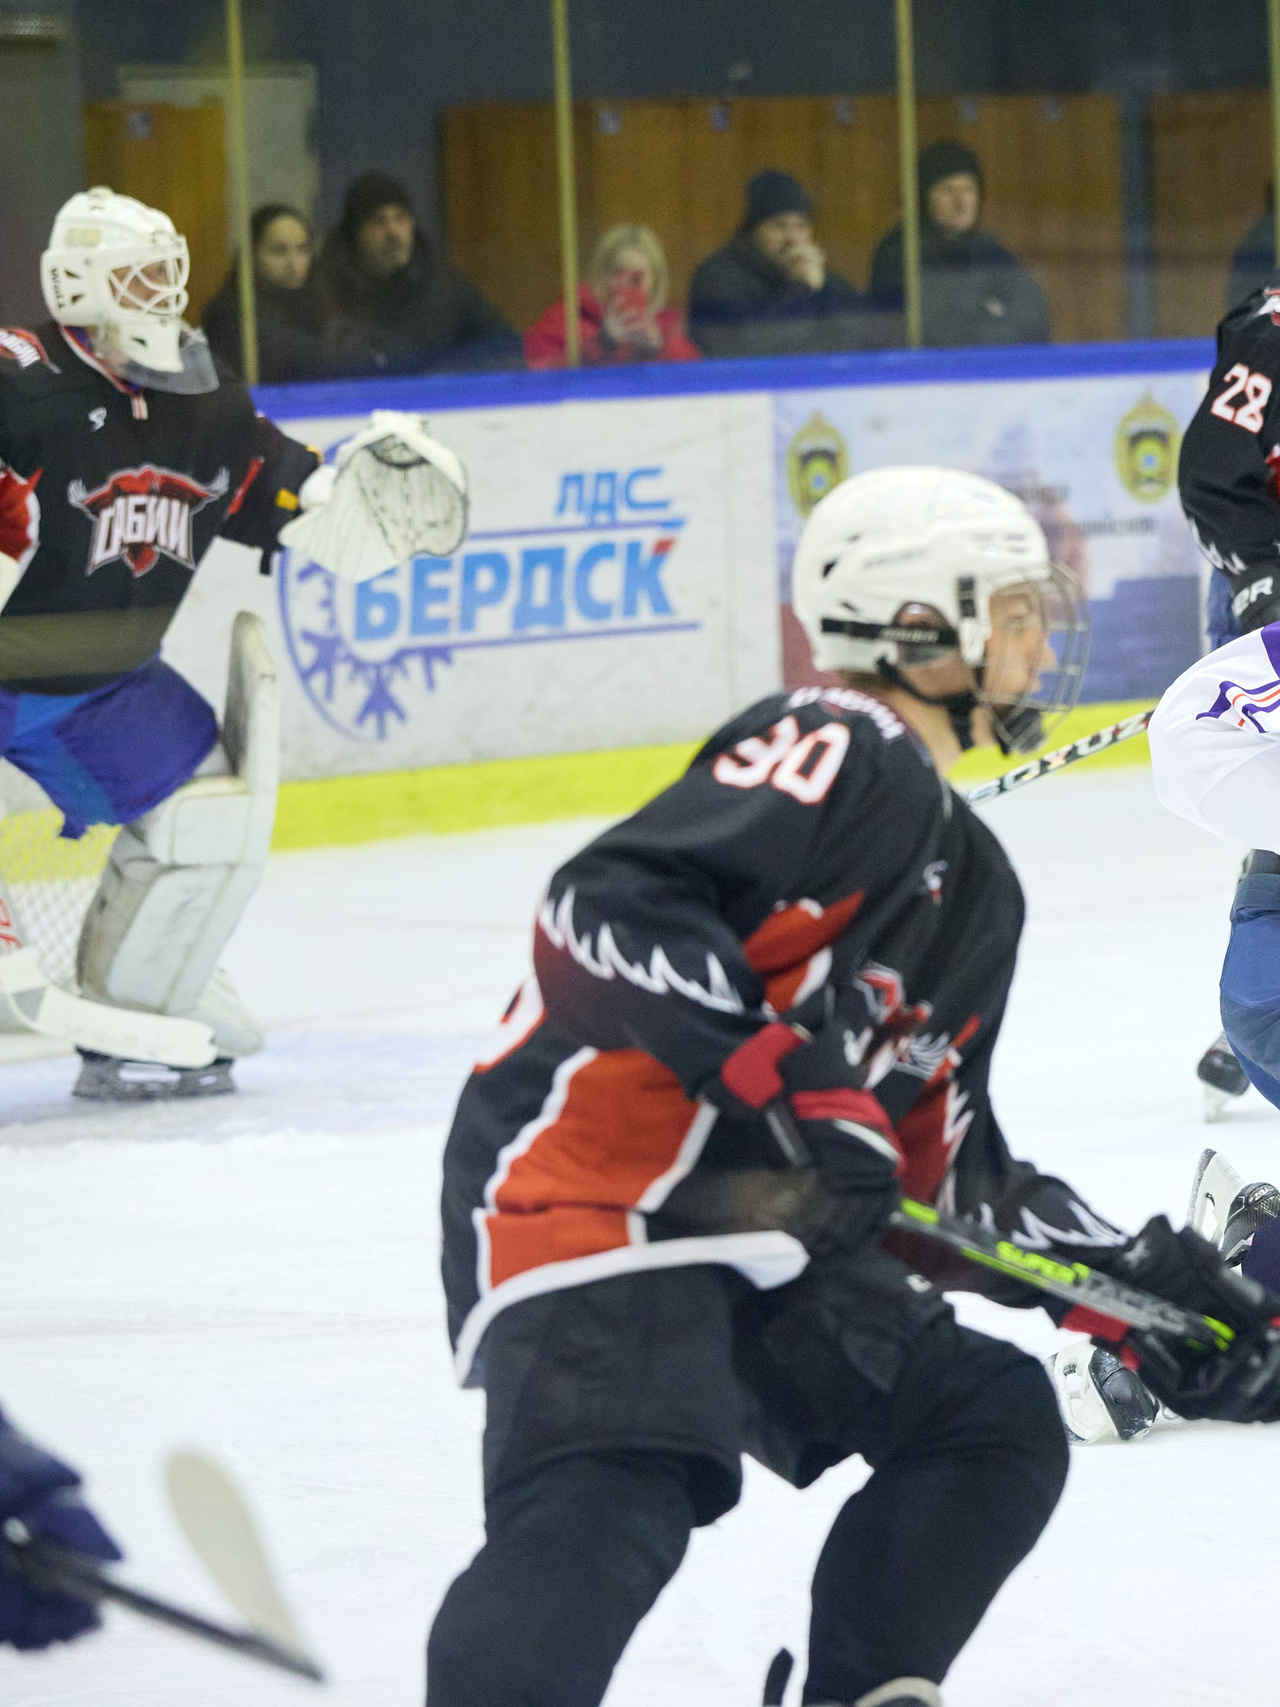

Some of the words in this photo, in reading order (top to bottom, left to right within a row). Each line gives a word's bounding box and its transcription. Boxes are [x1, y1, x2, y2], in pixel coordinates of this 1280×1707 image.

[1211, 362, 1273, 434] 28
[556, 467, 671, 525] ЛДС
[354, 538, 677, 642] БЕРДСК
